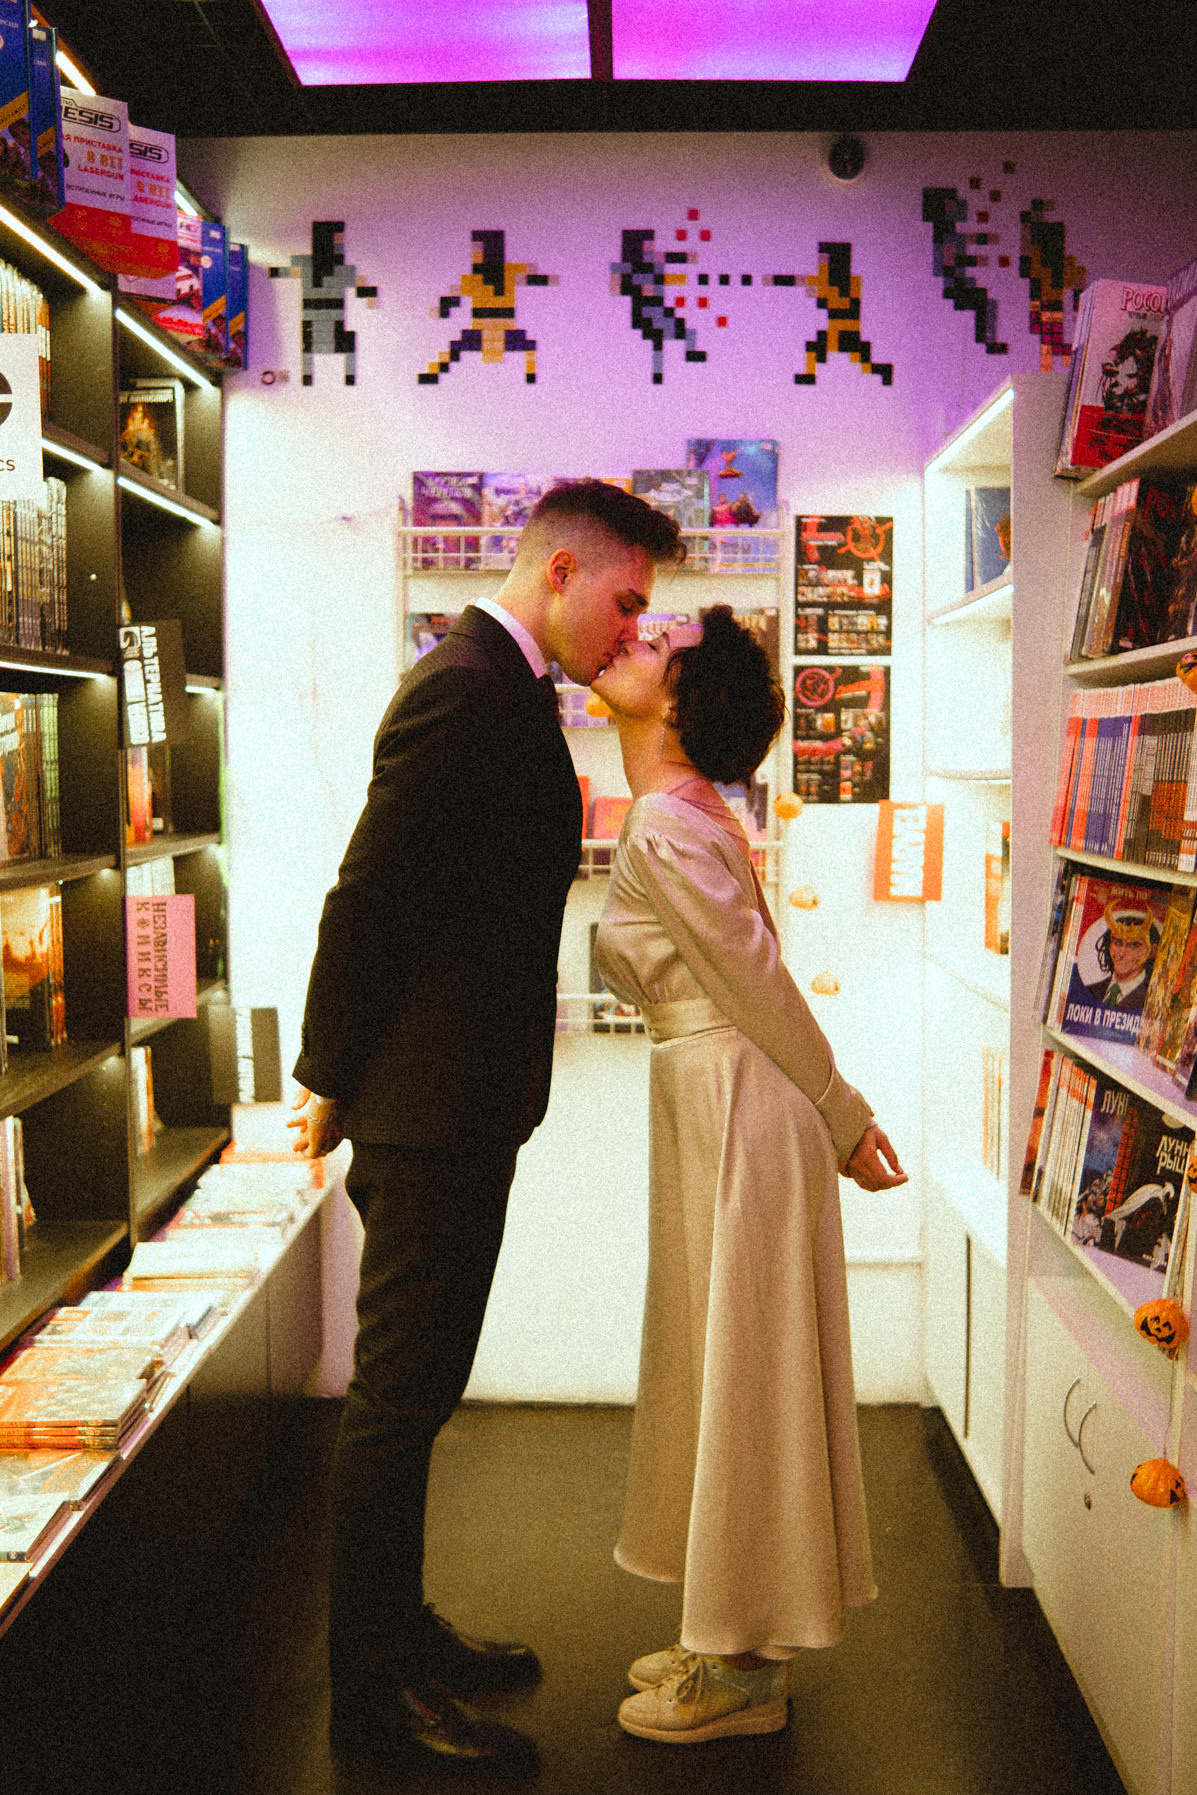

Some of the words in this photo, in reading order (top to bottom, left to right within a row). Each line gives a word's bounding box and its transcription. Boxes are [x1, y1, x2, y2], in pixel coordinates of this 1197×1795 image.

[73, 135, 123, 154] ПРИСТАВКА
[77, 164, 125, 181] LASERGUN
[99, 153, 124, 170] BIT
[140, 625, 167, 744] АЛЬТЕРНАТИВА
[889, 804, 928, 897] MARVEL
[136, 901, 152, 1012] КОМИКСЫ
[152, 901, 169, 1013] НЕЗАВИСИМЫЕ
[1065, 1002, 1094, 1025] ЛОКИ
[1093, 1007, 1102, 1026] В
